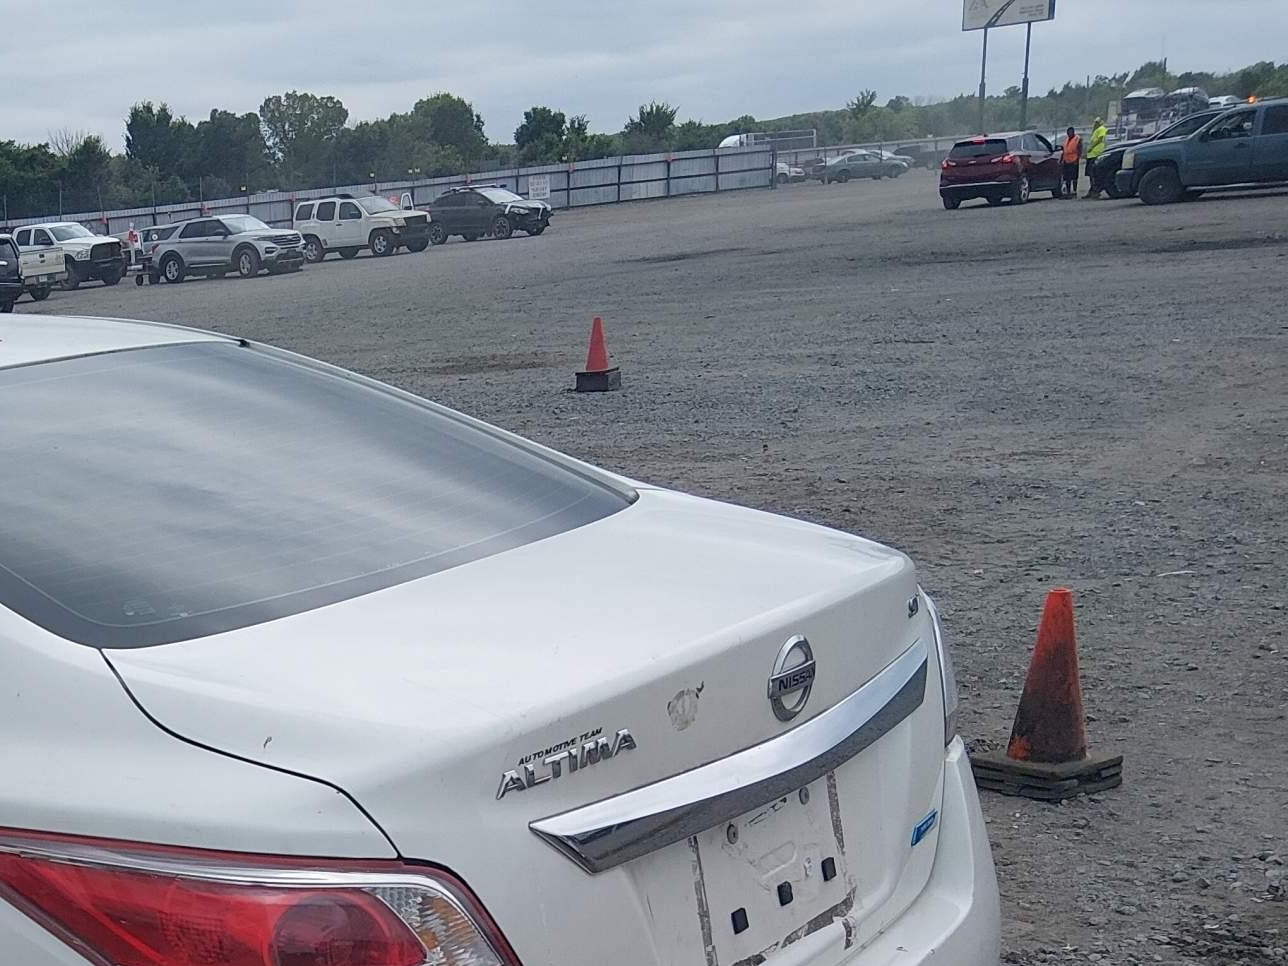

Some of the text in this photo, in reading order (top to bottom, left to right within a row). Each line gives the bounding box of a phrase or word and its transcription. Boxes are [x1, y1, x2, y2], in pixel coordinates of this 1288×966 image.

[496, 728, 637, 801] ALTIMA
[517, 727, 603, 767] AUTOMOTIVE TEAM
